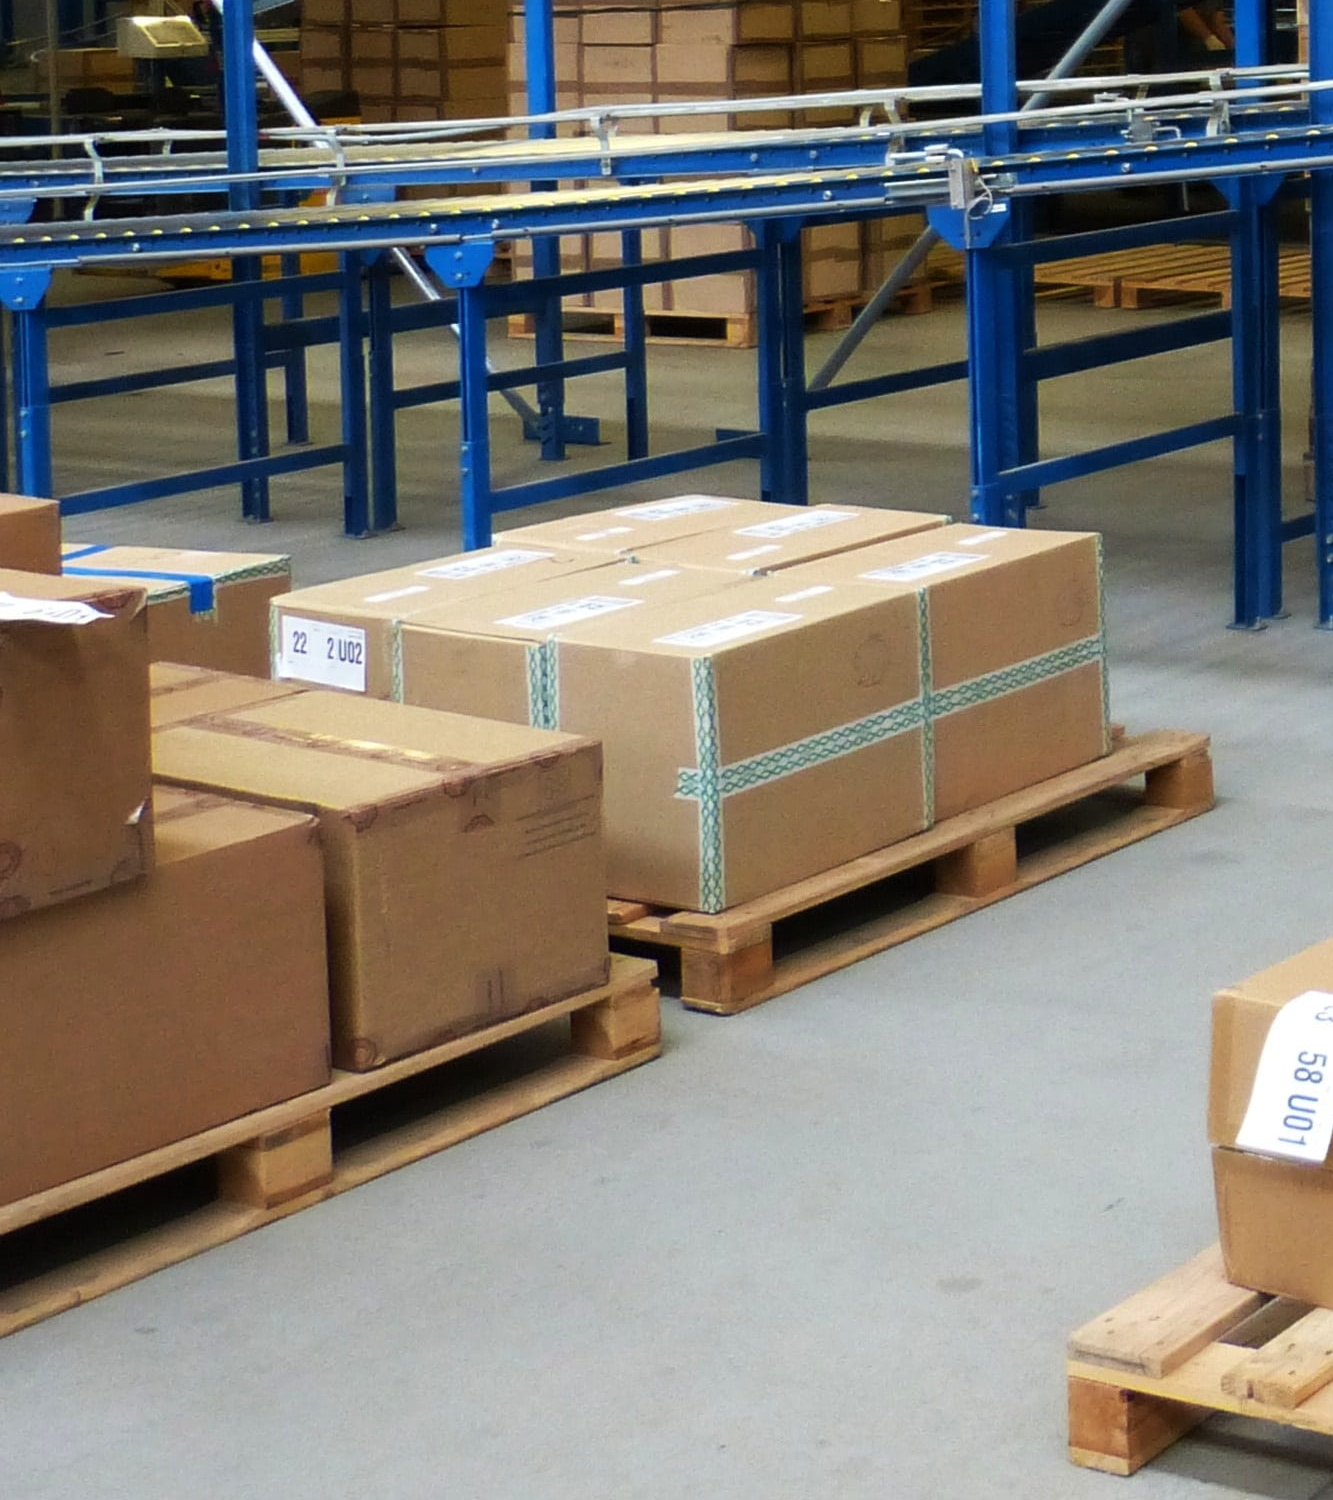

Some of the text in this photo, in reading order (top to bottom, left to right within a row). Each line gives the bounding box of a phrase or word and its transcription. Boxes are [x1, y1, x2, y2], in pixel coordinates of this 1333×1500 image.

[293, 630, 363, 665] 22 2 U02
[1293, 1051, 1327, 1084] 58
[1277, 1094, 1319, 1146] U01
